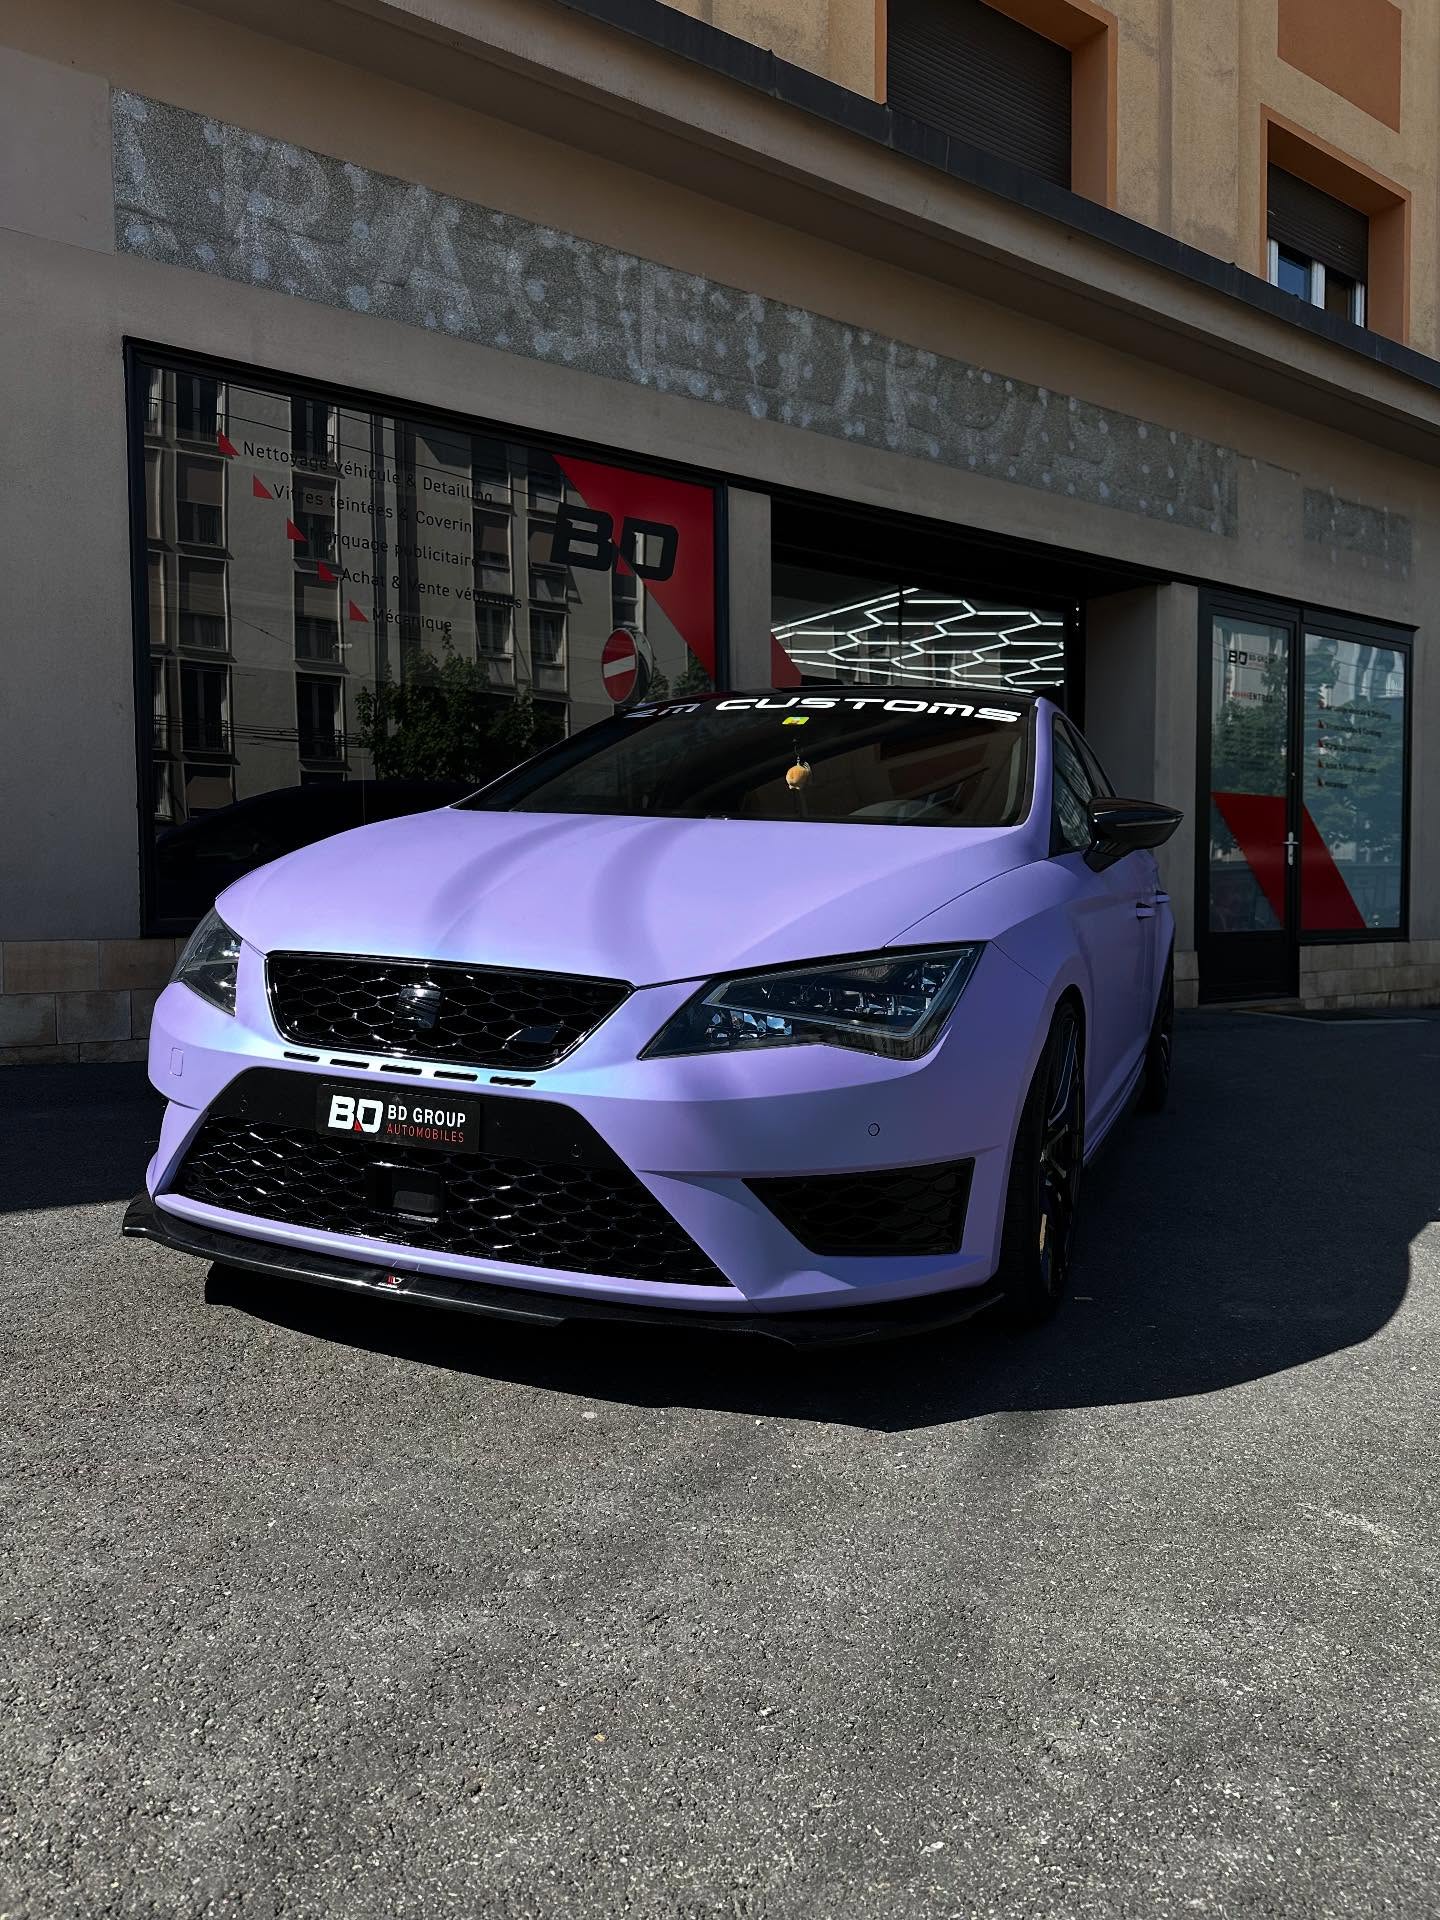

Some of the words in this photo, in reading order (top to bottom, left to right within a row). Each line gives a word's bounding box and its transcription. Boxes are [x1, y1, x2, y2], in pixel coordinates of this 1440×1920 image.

[243, 440, 329, 472] Nettoyage
[334, 460, 400, 485] véhicule
[406, 473, 417, 488] &
[273, 484, 324, 506] Vites
[331, 495, 393, 519] teintées
[416, 510, 473, 534] Coverin
[318, 527, 388, 554] arquage
[395, 542, 479, 568] publicitaire
[551, 502, 680, 582] BD
[341, 567, 384, 588] Achat
[391, 575, 401, 589] &
[407, 577, 449, 597] Vente
[372, 607, 452, 633] Mécanique
[715, 697, 1022, 723] CUSTOMS
[327, 1094, 384, 1134] BD
[387, 1104, 408, 1121] BD
[412, 1107, 466, 1128] GROUP
[386, 1123, 465, 1143] AUTOMOBILES
